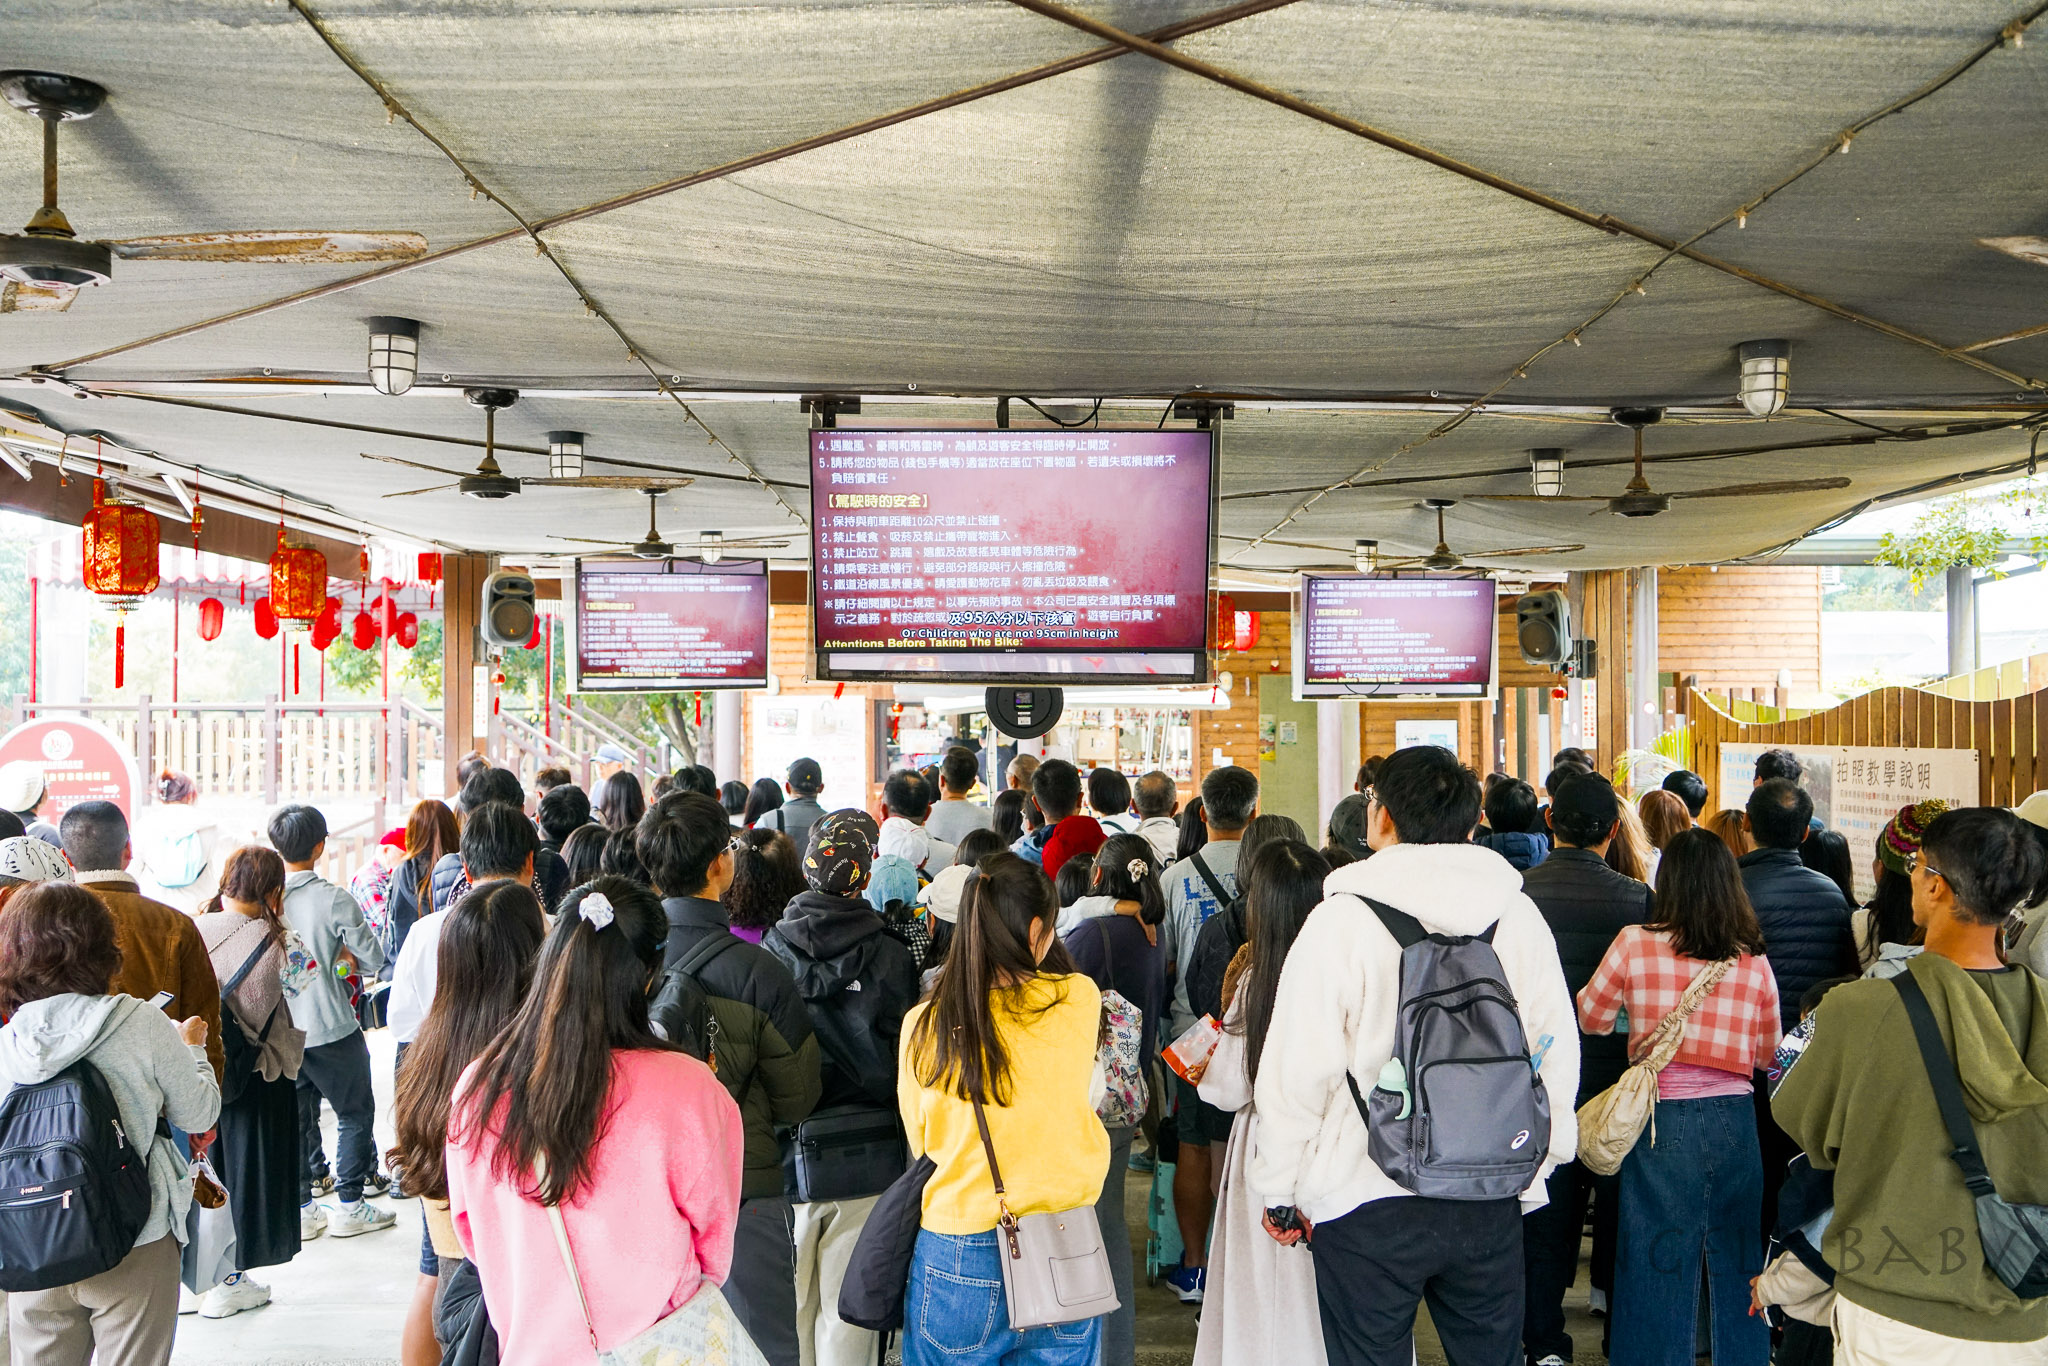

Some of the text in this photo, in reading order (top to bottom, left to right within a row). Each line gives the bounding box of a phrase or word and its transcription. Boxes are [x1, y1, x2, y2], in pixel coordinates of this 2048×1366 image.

[831, 473, 897, 484] 負賠償責任。
[828, 494, 928, 508] 【駕駛時的安全】
[948, 611, 1077, 627] 及95公分以下孩童
[901, 628, 1119, 640] Or Children who are not 95cm in height
[823, 637, 1023, 648] Attentions Before Taking The Bike:
[1837, 757, 1931, 790] 拍照教學說明
